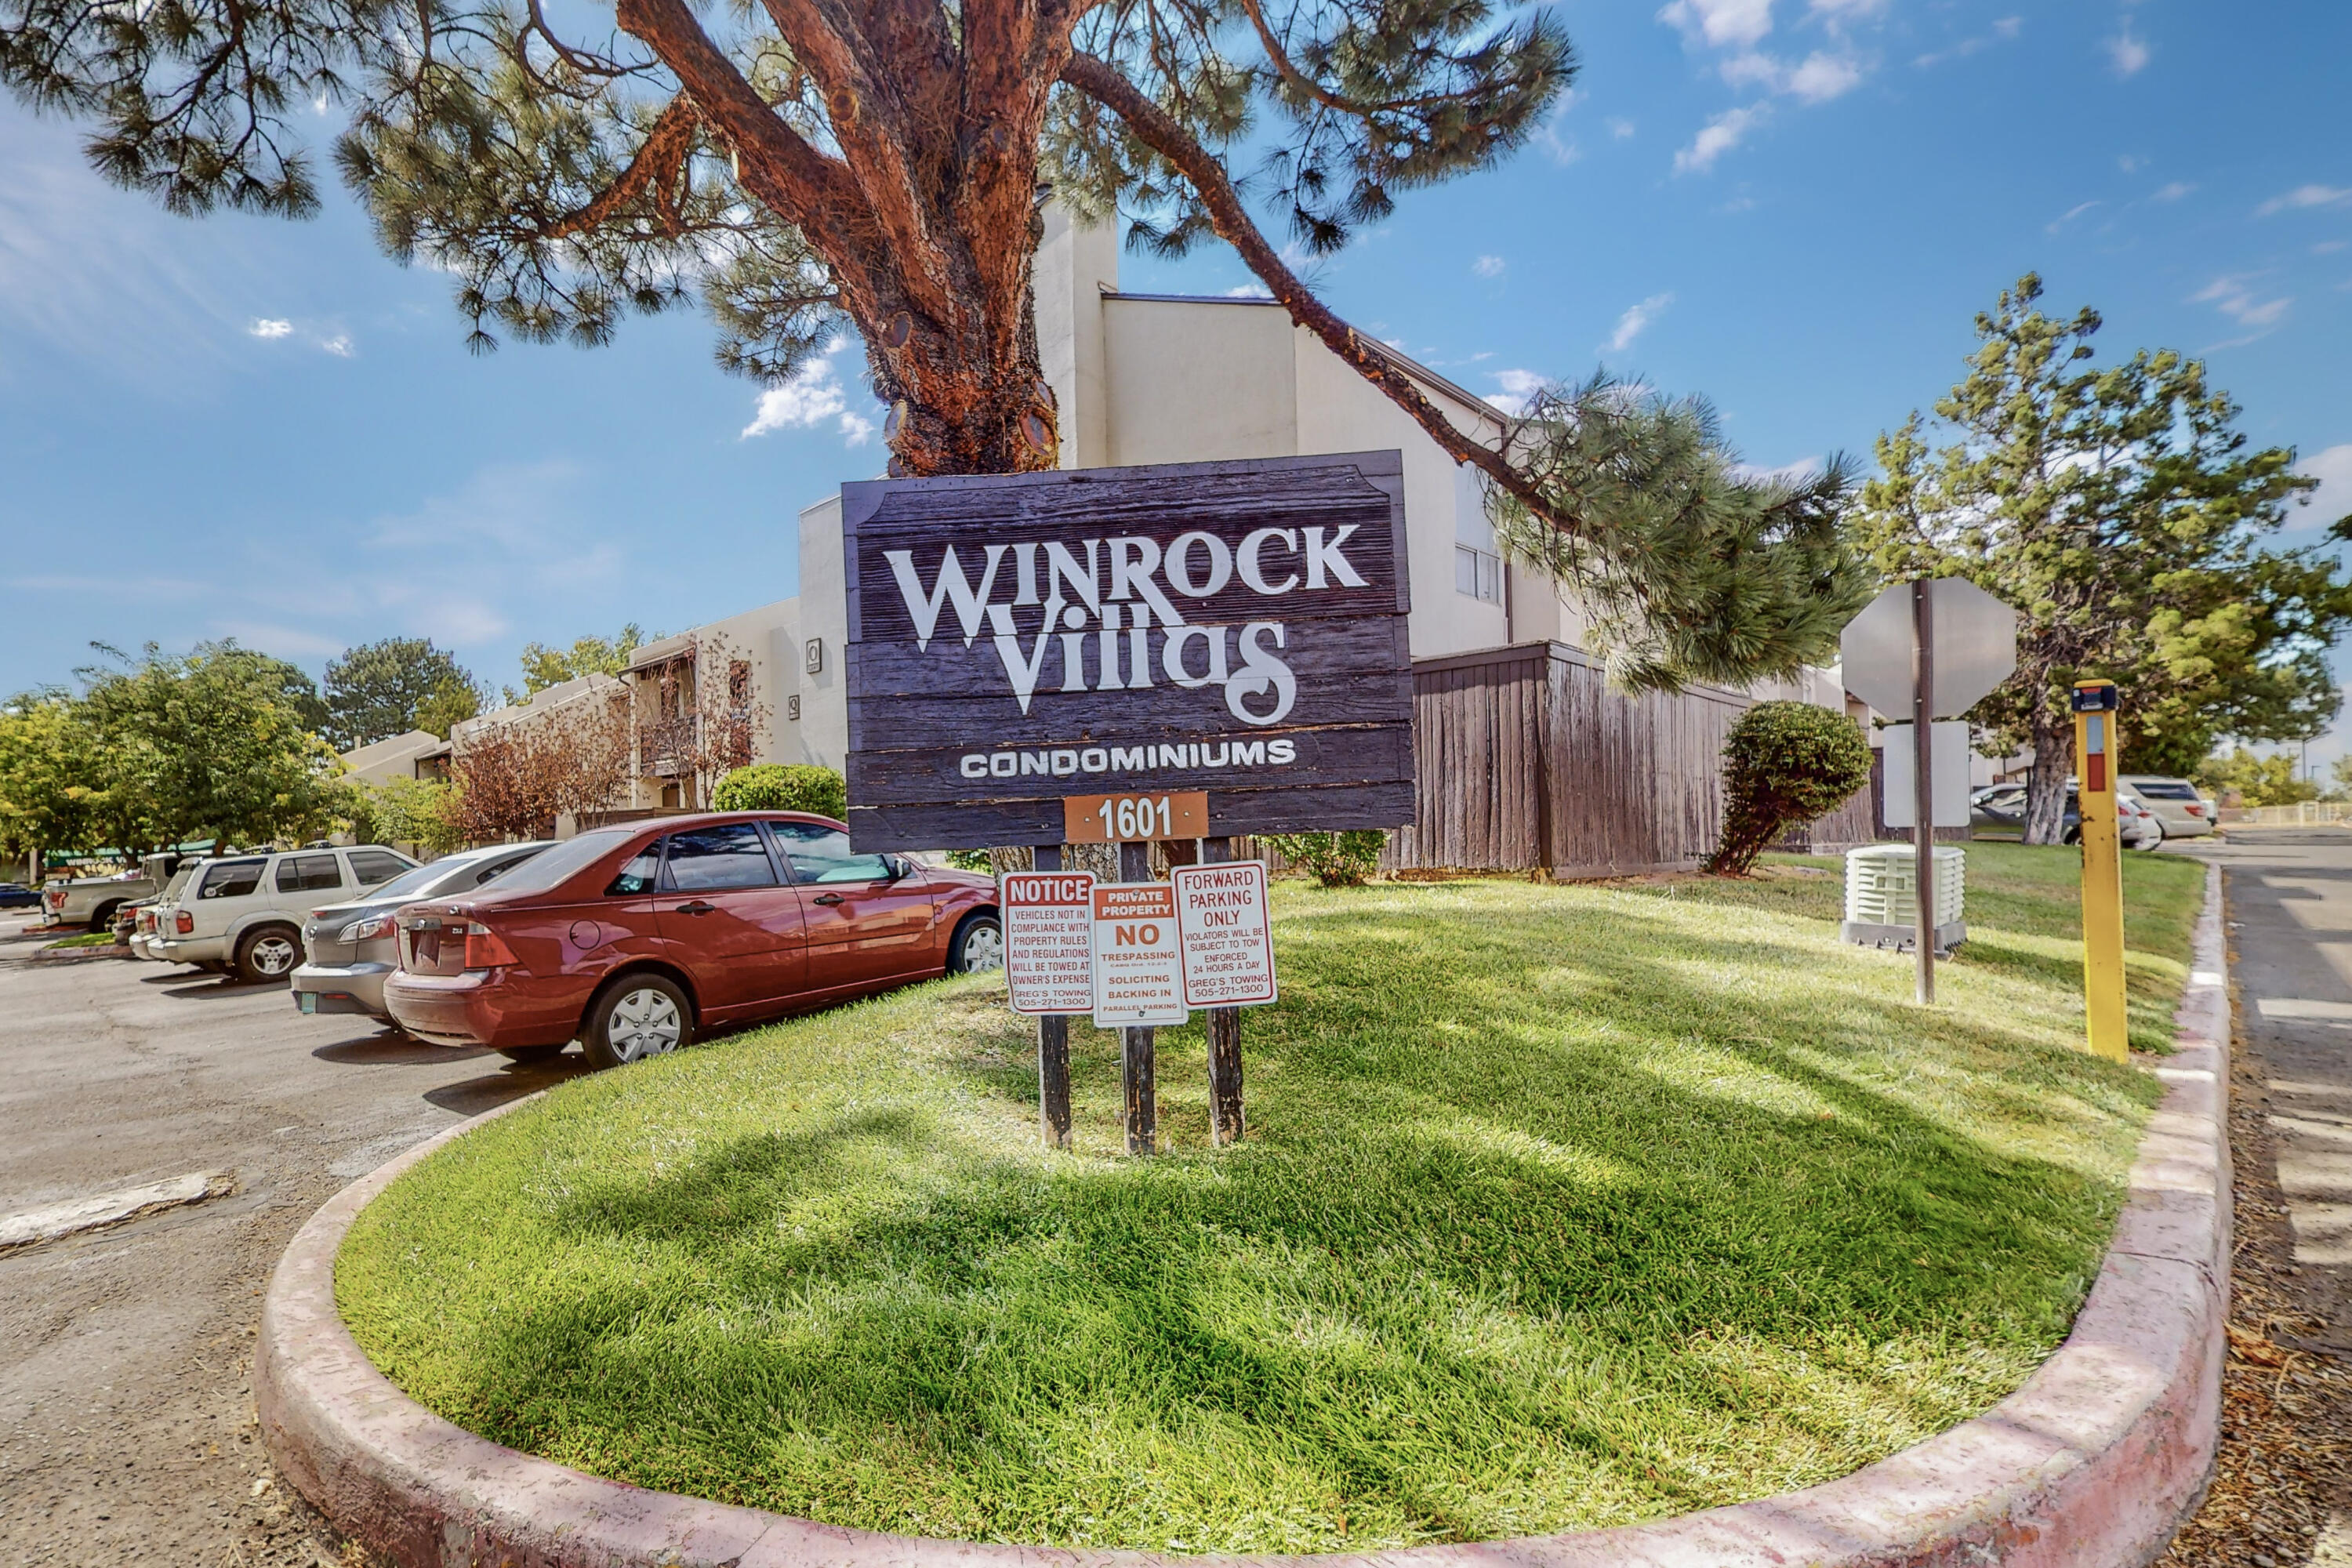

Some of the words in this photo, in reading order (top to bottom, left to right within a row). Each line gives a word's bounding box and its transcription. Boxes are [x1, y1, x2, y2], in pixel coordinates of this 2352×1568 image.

[882, 524, 1370, 654] WINROCK
[986, 604, 1297, 725] Villas
[960, 739, 1295, 778] CONDOMINIUMS
[1098, 797, 1171, 840] 1601
[1185, 871, 1253, 890] FORWARD
[1011, 879, 1087, 902] NOTICE
[1108, 891, 1163, 903] PRIVATE
[1189, 891, 1252, 909] PARKING
[1015, 910, 1054, 920] VEHICLES
[1058, 910, 1074, 919] NOT
[1077, 910, 1085, 919] IN
[1102, 904, 1171, 916] PROPERTY
[1204, 909, 1240, 927] ONLY
[1011, 924, 1065, 933] COMPLIANCE
[1068, 923, 1089, 932] WITH
[1116, 924, 1160, 946] NO
[1185, 931, 1228, 941] VIOLATORS
[1014, 937, 1057, 946] PROPERTY
[1060, 936, 1087, 945] RULES
[1190, 942, 1225, 952] SUBJECT
[1013, 949, 1029, 958] AND
[1033, 949, 1089, 958] REGULATIONS
[1101, 951, 1175, 961] TRESPASSING
[1205, 953, 1247, 963] ENFORCED
[1012, 963, 1032, 971] WILL
[1036, 963, 1045, 971] BE
[1048, 962, 1077, 971] TOWED
[1207, 963, 1234, 973] HOURS
[1013, 975, 1050, 985] OWNER'S
[1053, 975, 1090, 983] EXPENSE
[1109, 975, 1169, 985] SOLICITING
[1189, 978, 1225, 988] GREG'S
[1229, 974, 1268, 984] TOWING
[1109, 990, 1156, 999] BACKING
[1195, 985, 1263, 997] 505-271-1300
